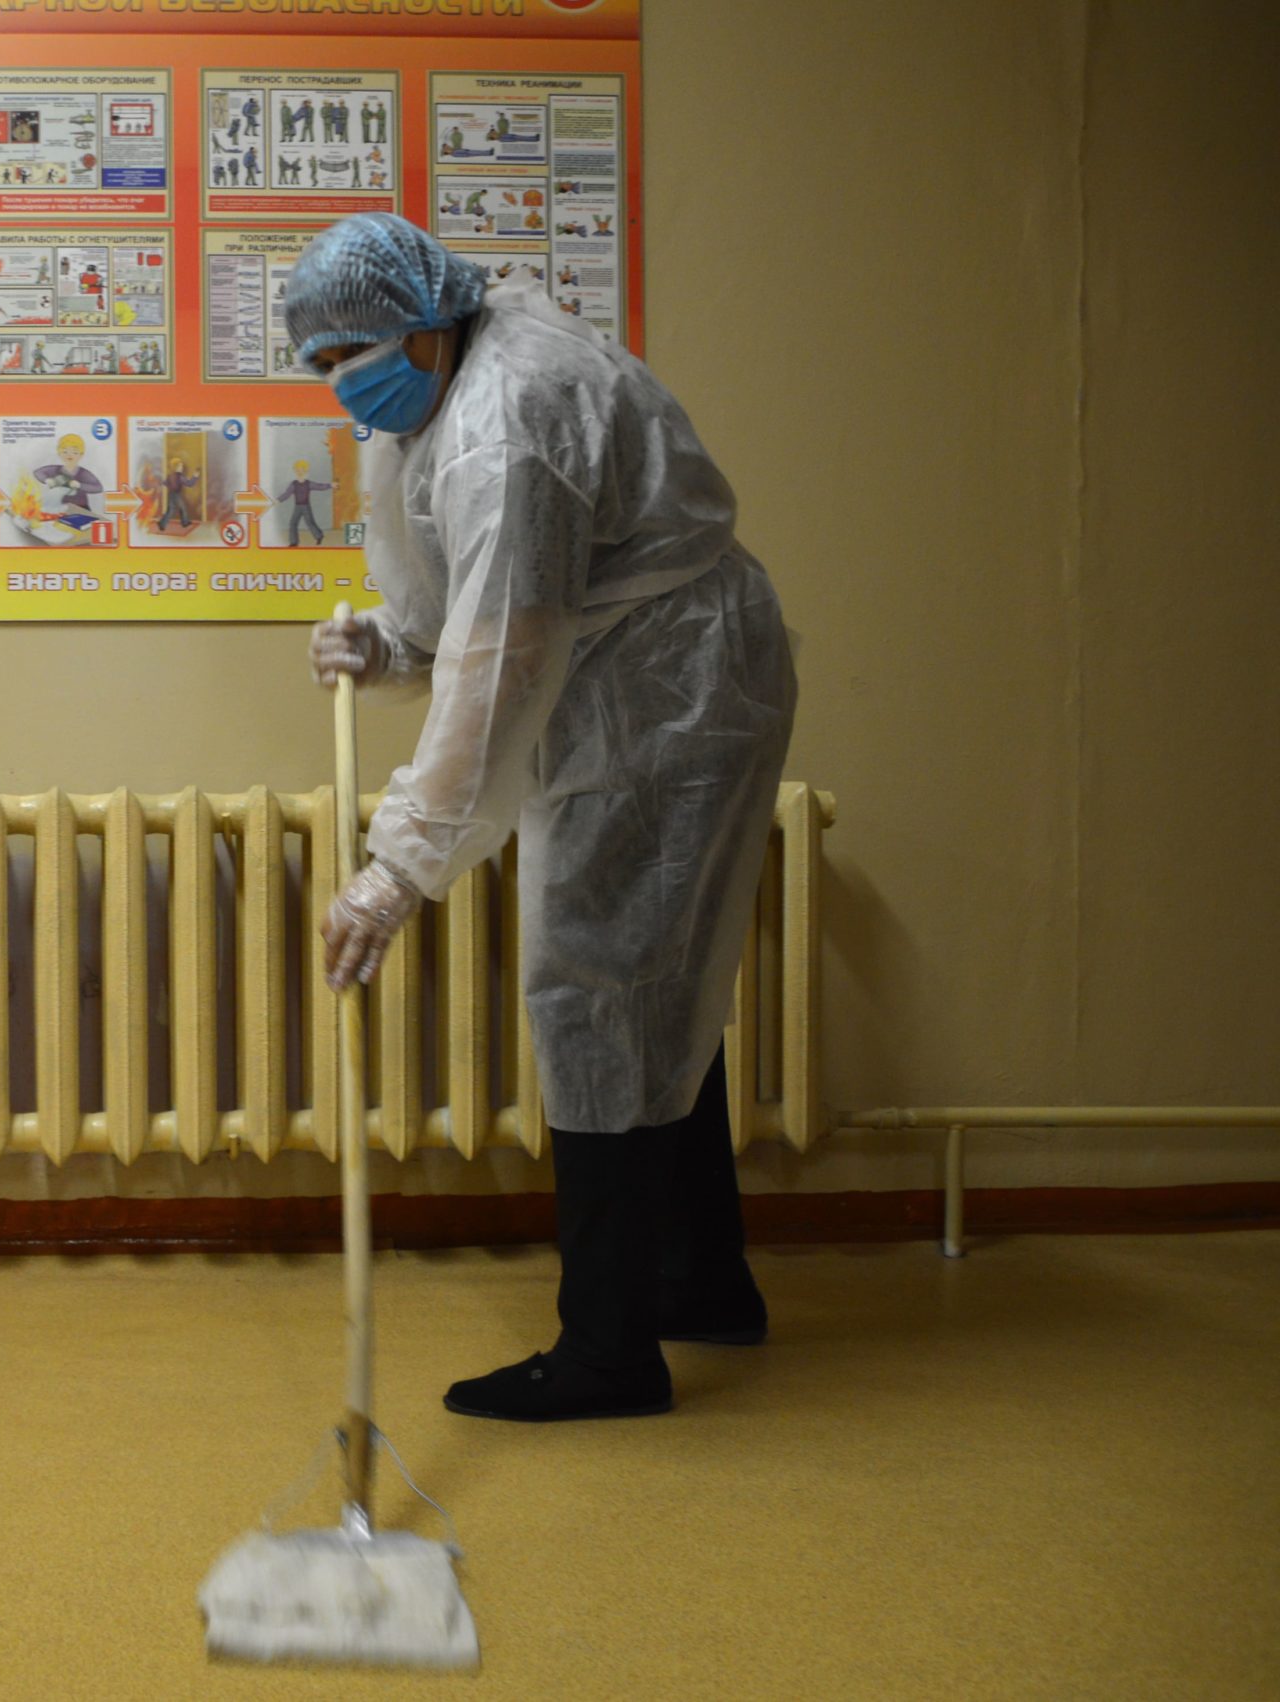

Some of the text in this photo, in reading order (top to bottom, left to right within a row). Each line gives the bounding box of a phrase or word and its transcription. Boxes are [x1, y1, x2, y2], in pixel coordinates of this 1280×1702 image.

[82, 76, 156, 85] ОБОРУДОВАНИЕ
[239, 76, 363, 85] ПЕРЕНОС ПОСТРАДАВШИХ
[476, 79, 583, 88] ТЕХНИКА РЕАНИМАЦИИ
[240, 234, 297, 242] ПОЛОЖЕНИЕ
[224, 244, 242, 252] ПРИ
[96, 423, 108, 436] 3
[227, 423, 239, 437] 4
[356, 425, 368, 437] 5
[7, 572, 99, 591] знать
[111, 572, 198, 596] пора:
[210, 572, 323, 592] спички
